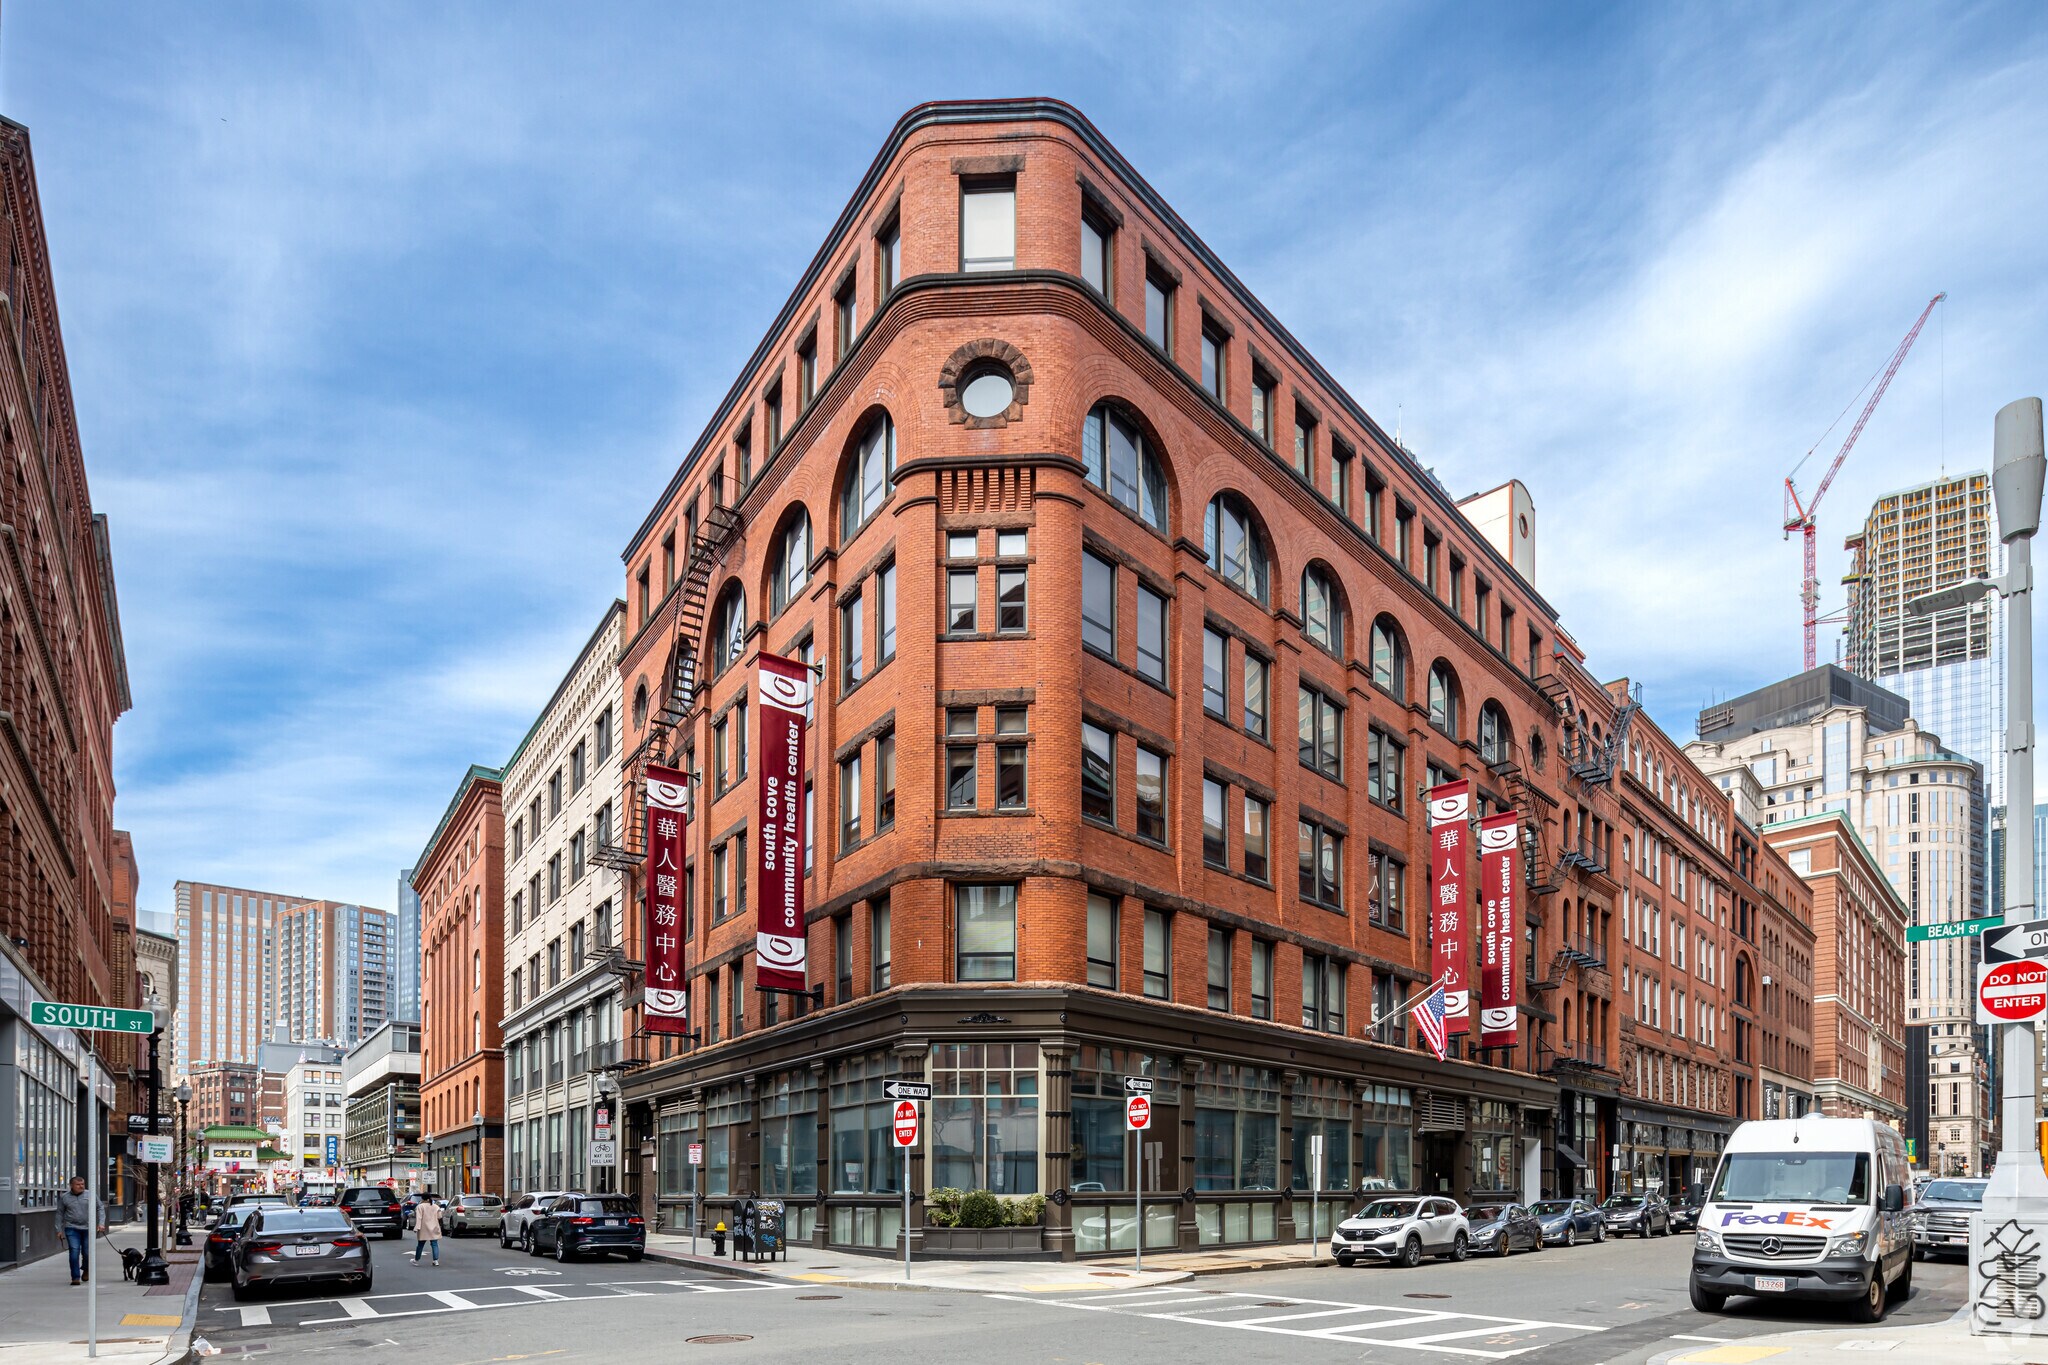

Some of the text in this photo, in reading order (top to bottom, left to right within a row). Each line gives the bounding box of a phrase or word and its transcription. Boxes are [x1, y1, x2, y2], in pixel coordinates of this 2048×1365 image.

[763, 776, 778, 871] south cove
[782, 720, 799, 928] community health center
[655, 817, 678, 982] 華人醫務中心
[1439, 829, 1460, 985] 華人醫務中心
[1486, 899, 1496, 965] south cove
[1499, 856, 1513, 1001] community health center
[1928, 922, 1980, 938] BEACH ST
[1989, 970, 2047, 985] DO NOT
[1993, 996, 2041, 1009] ENTER
[43, 1005, 142, 1030] SOUTH ST
[897, 1086, 927, 1095] ONE WAY
[897, 1109, 915, 1118] DO NOT
[898, 1129, 913, 1137] ENTER
[328, 1137, 336, 1162] PARK
[1720, 1211, 1834, 1231] FedEx
